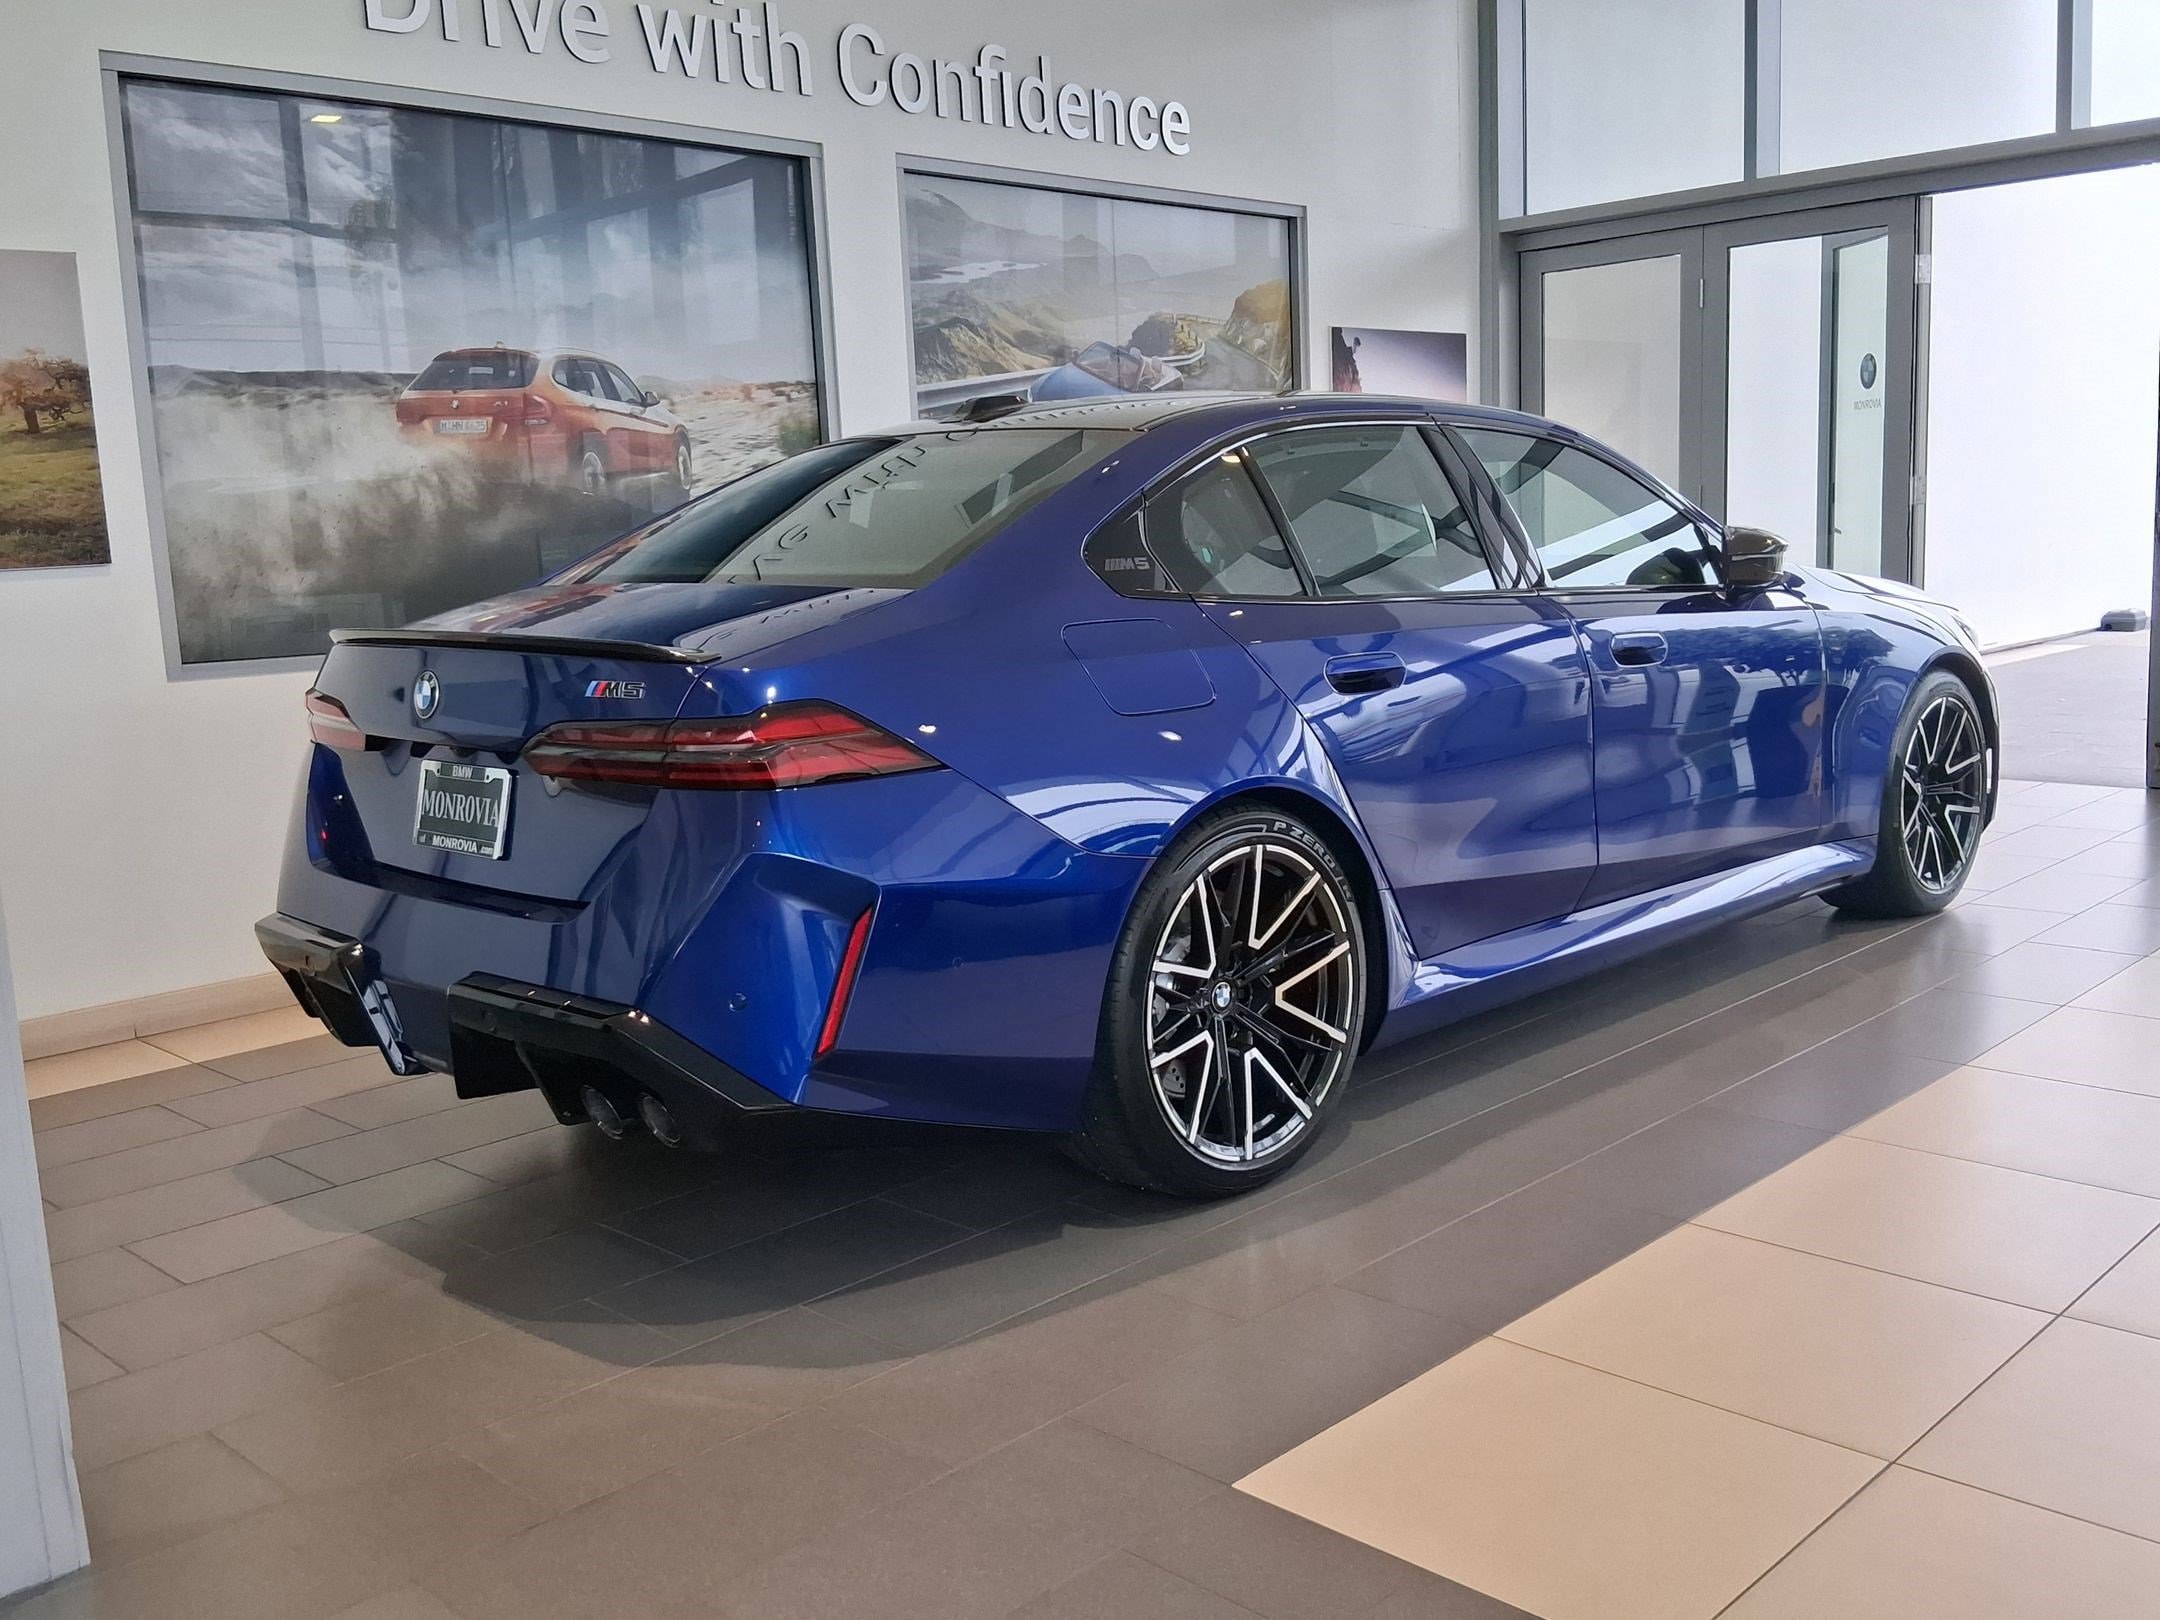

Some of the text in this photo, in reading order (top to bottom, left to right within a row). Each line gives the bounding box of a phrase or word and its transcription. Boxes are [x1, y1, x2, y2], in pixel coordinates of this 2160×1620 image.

[635, 0, 814, 97] with
[836, 23, 1191, 156] Confidence
[452, 765, 473, 779] BMW
[421, 788, 500, 828] MONROVIA
[431, 834, 479, 854] MONROVIA
[1273, 821, 1336, 869] P ZERO
